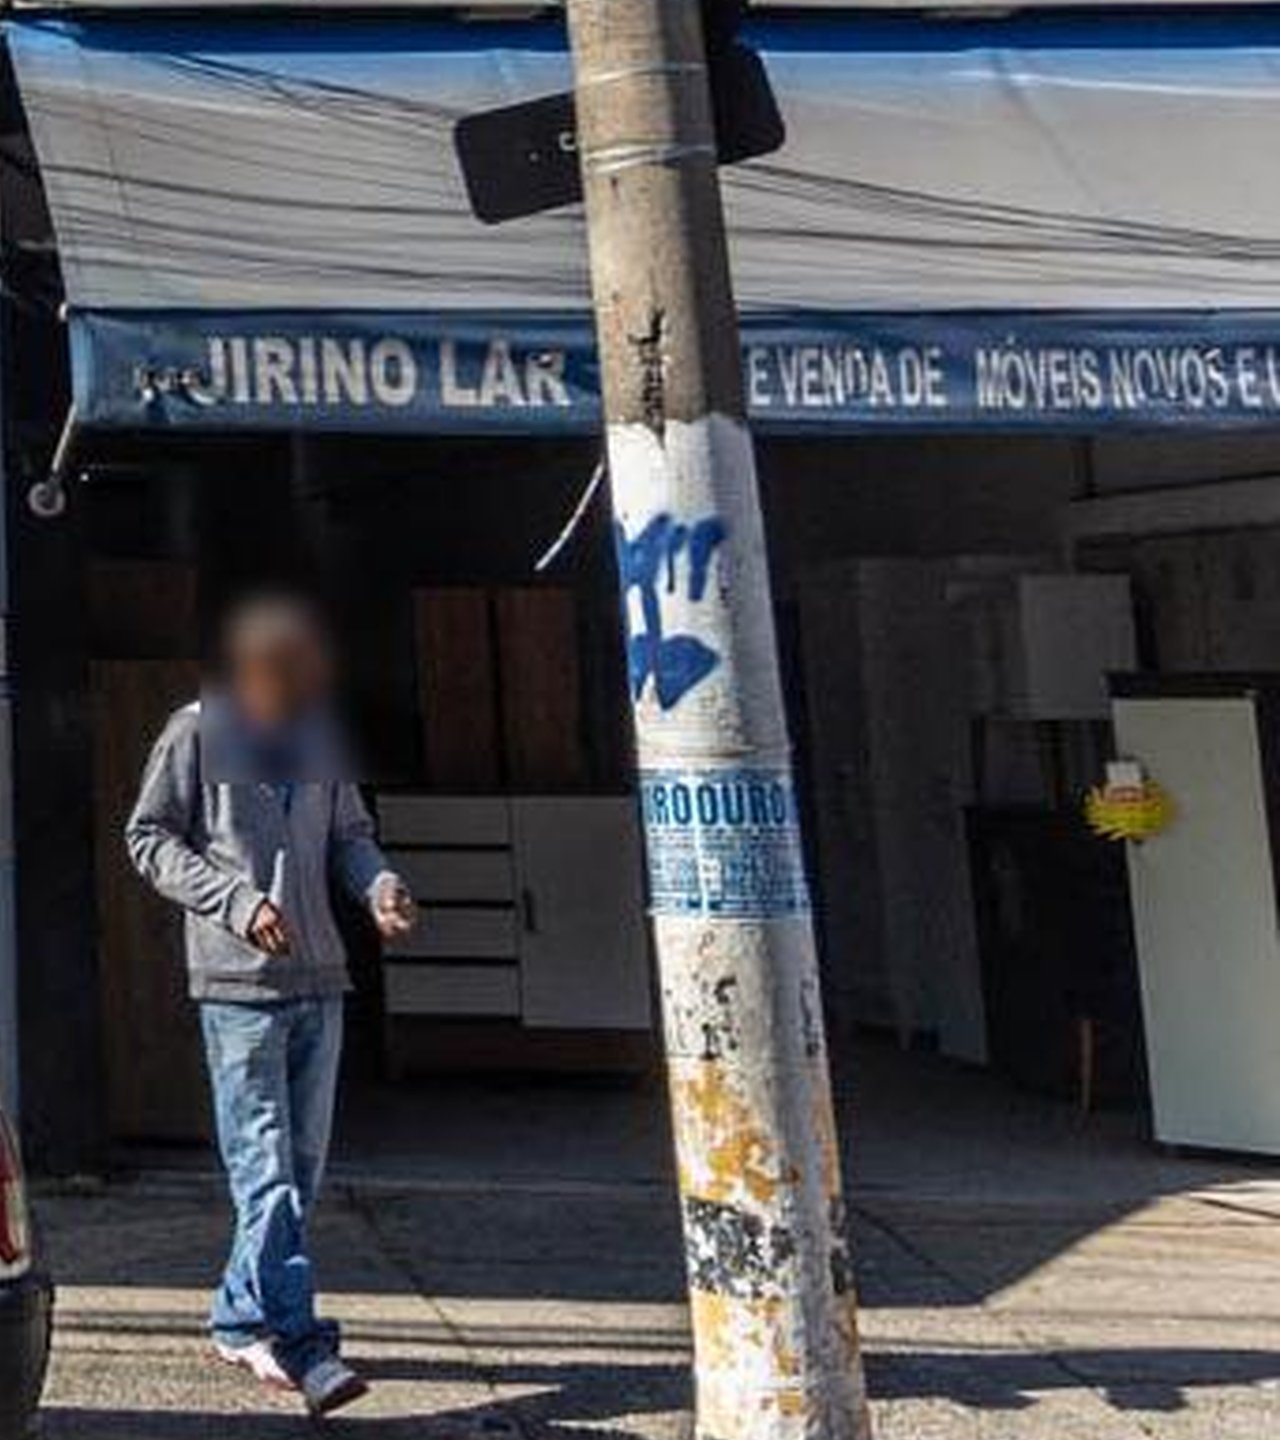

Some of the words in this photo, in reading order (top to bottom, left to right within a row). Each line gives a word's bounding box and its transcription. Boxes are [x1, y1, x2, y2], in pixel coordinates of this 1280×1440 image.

[748, 349, 771, 407] E
[778, 349, 896, 407] VENDA
[900, 349, 945, 407] DE
[976, 334, 1102, 408] MÓVEIS
[1108, 348, 1228, 409] NOVOS
[1236, 349, 1261, 407] E
